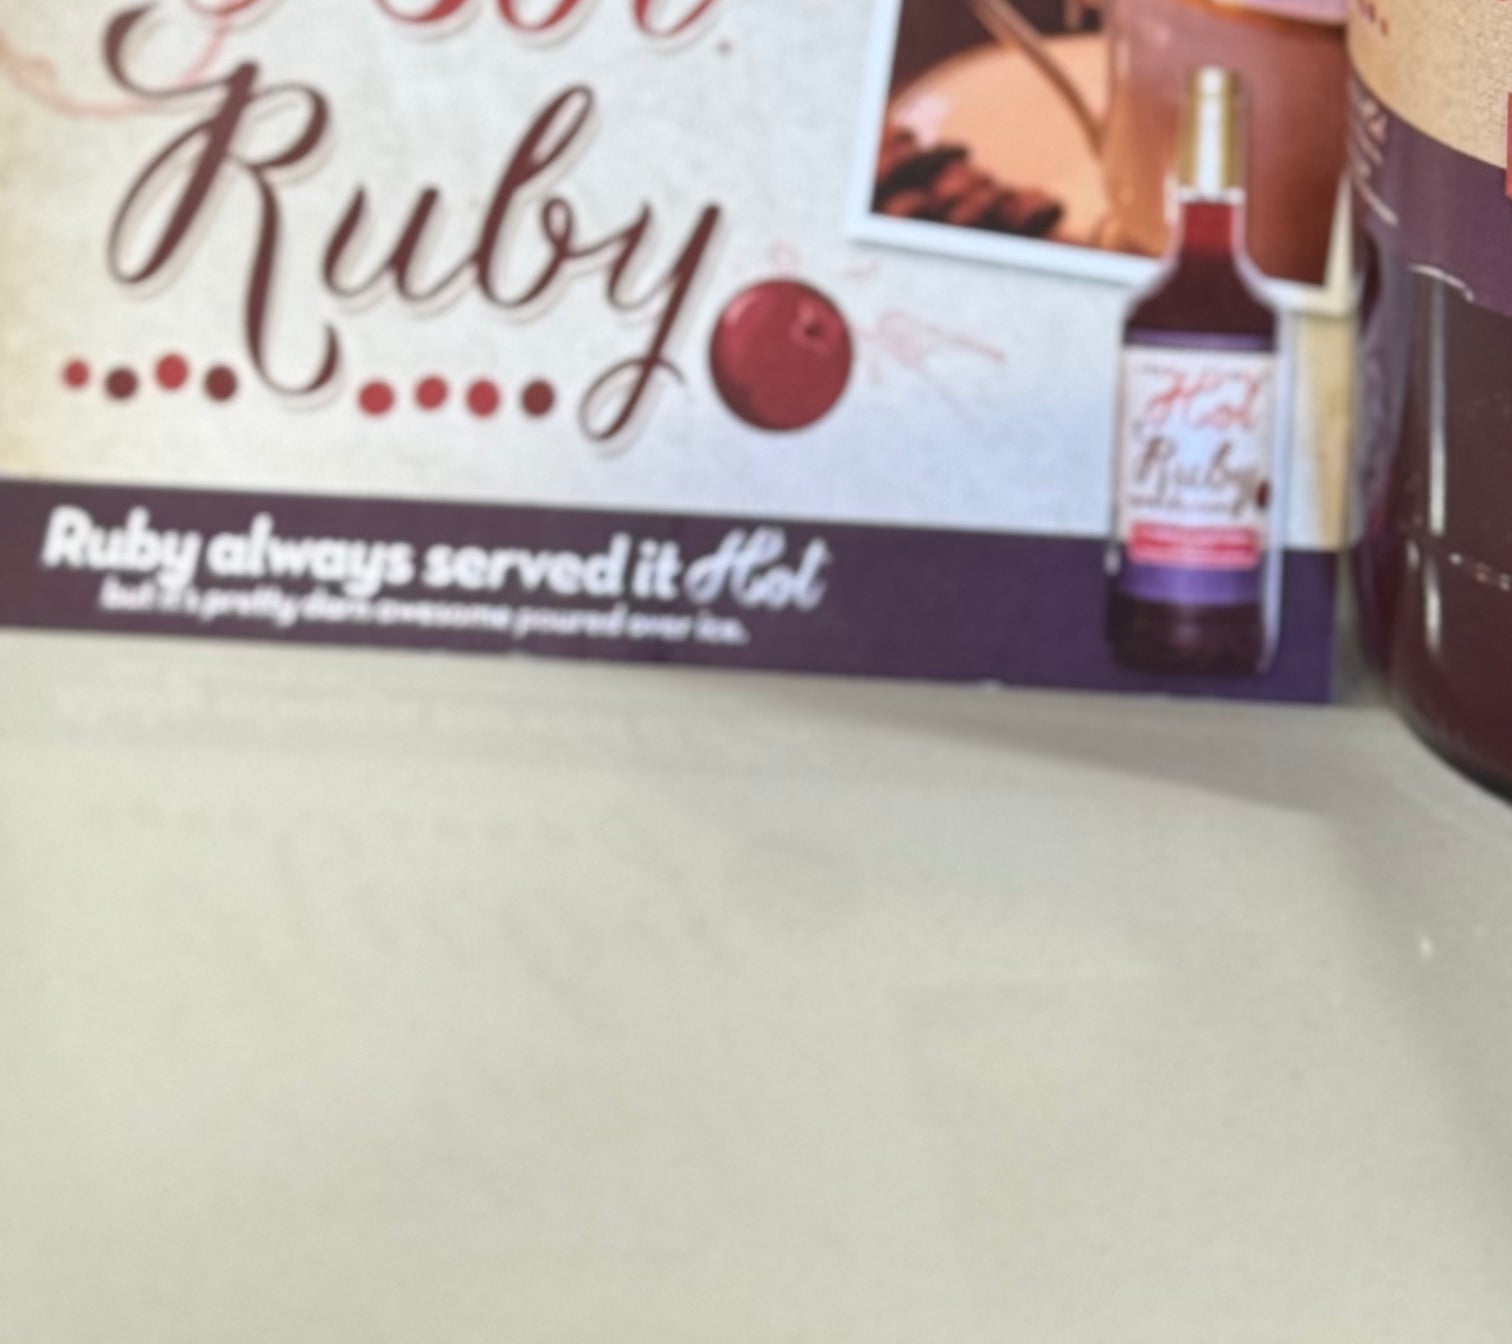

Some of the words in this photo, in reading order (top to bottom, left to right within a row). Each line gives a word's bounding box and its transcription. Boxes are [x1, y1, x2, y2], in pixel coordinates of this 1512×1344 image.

[102, 0, 724, 440] Ruby
[41, 504, 201, 589] Ruby
[206, 511, 415, 599] always
[422, 531, 632, 596] served
[632, 538, 682, 600] it
[684, 526, 831, 611] Hot
